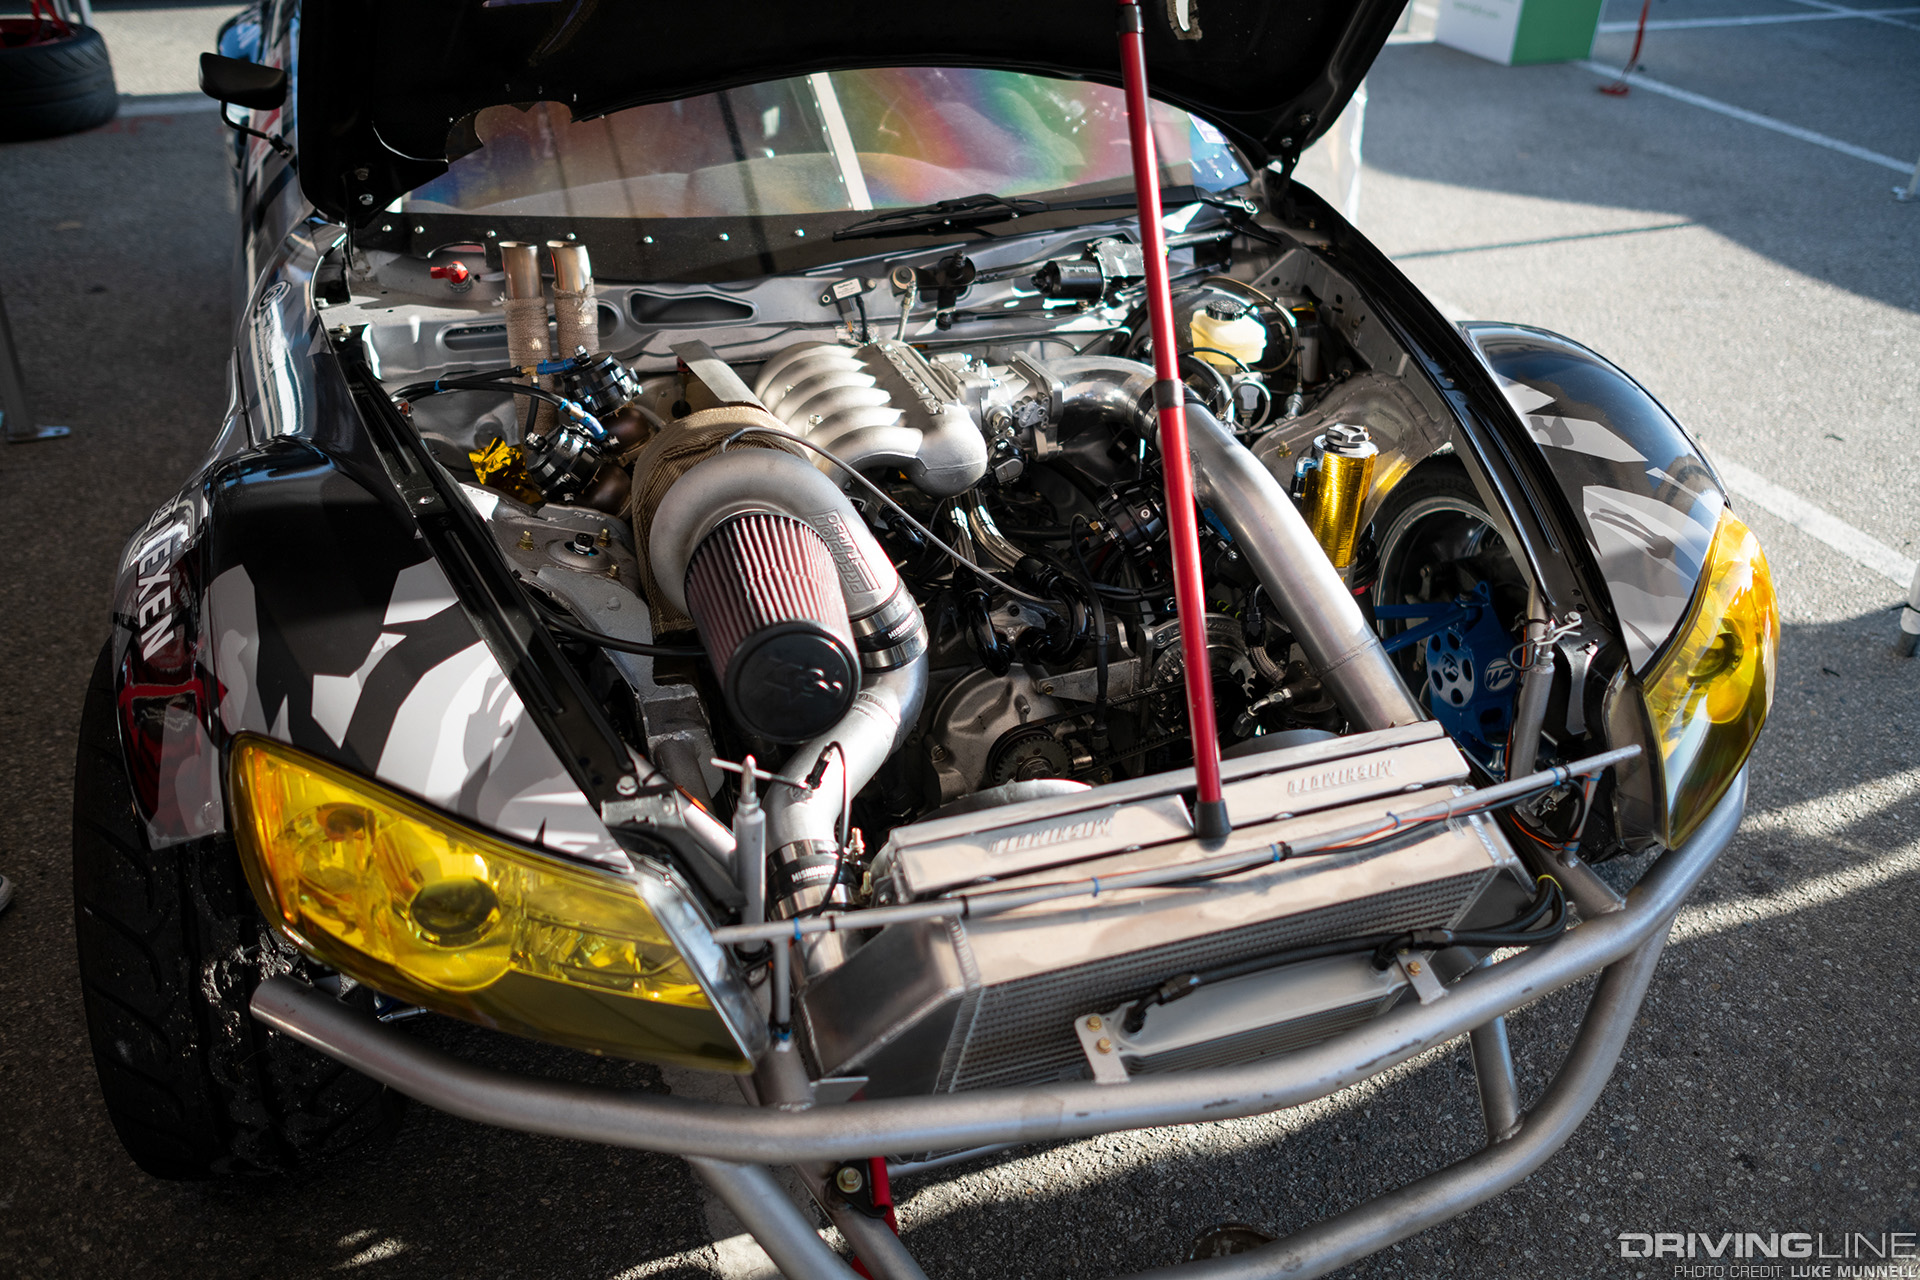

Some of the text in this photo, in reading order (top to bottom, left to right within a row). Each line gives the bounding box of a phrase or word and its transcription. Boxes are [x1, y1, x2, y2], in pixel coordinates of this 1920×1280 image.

[812, 514, 867, 594] PRECISION
[827, 514, 861, 563] TURBO
[888, 611, 917, 639] MISHIMO
[1287, 760, 1394, 797] MISHIMOTO
